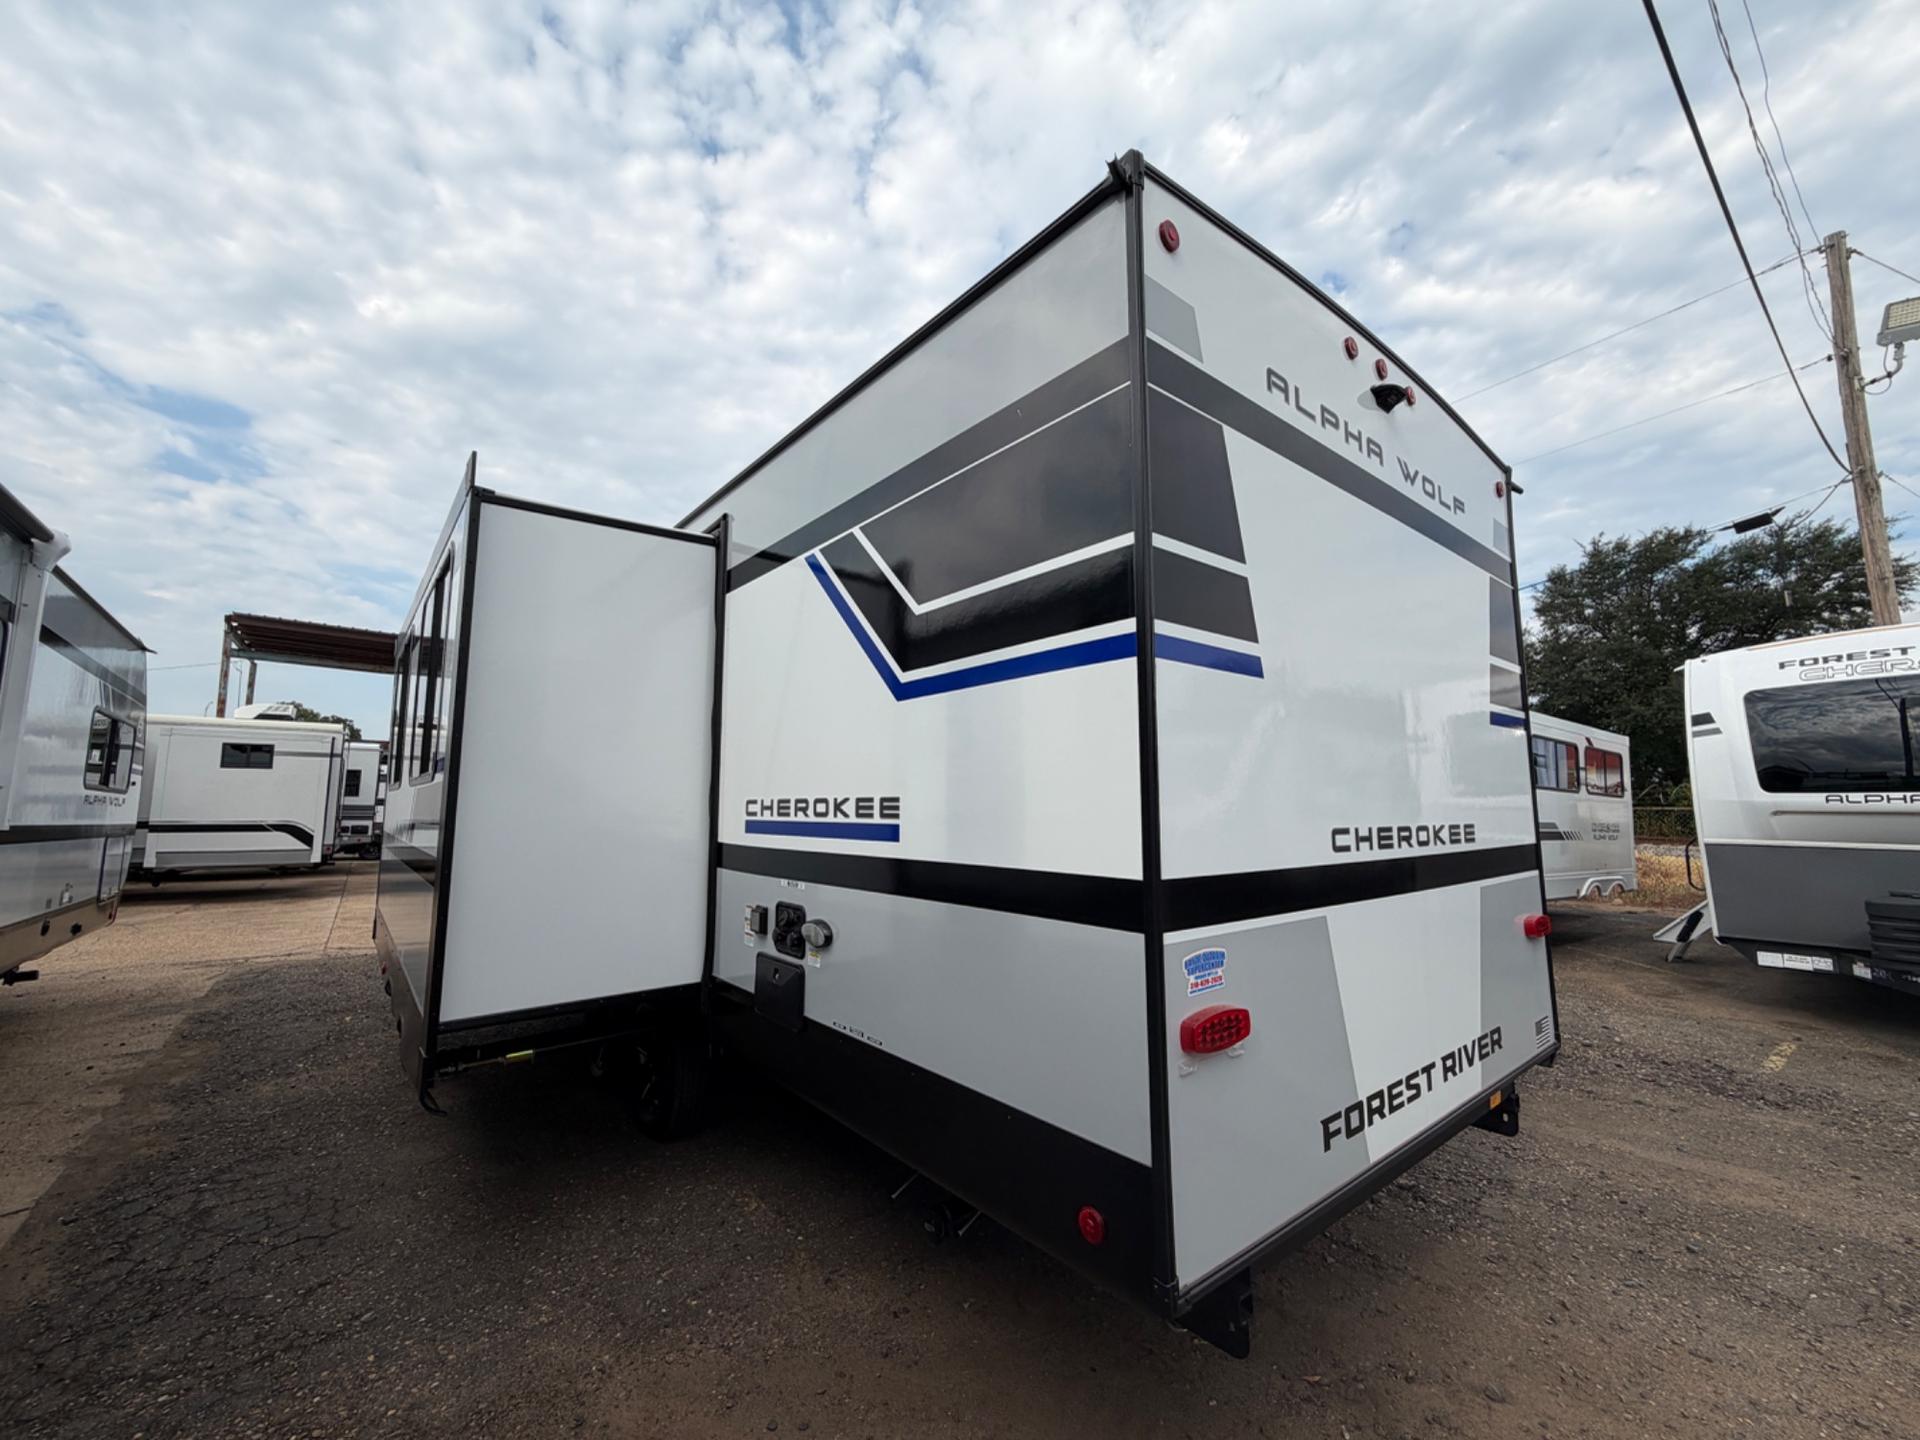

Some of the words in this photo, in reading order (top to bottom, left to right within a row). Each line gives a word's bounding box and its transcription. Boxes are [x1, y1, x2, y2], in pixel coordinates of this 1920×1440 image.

[1266, 367, 1384, 467] ALPHA
[1397, 455, 1465, 515] WOLF
[1778, 646, 1916, 670] FOREST
[1800, 658, 1920, 681] CHER
[745, 797, 900, 820] CHEROKEE
[1331, 823, 1476, 853] CHEROKEE
[1320, 1061, 1436, 1153] FOREST
[1440, 1026, 1504, 1083] RIVER
